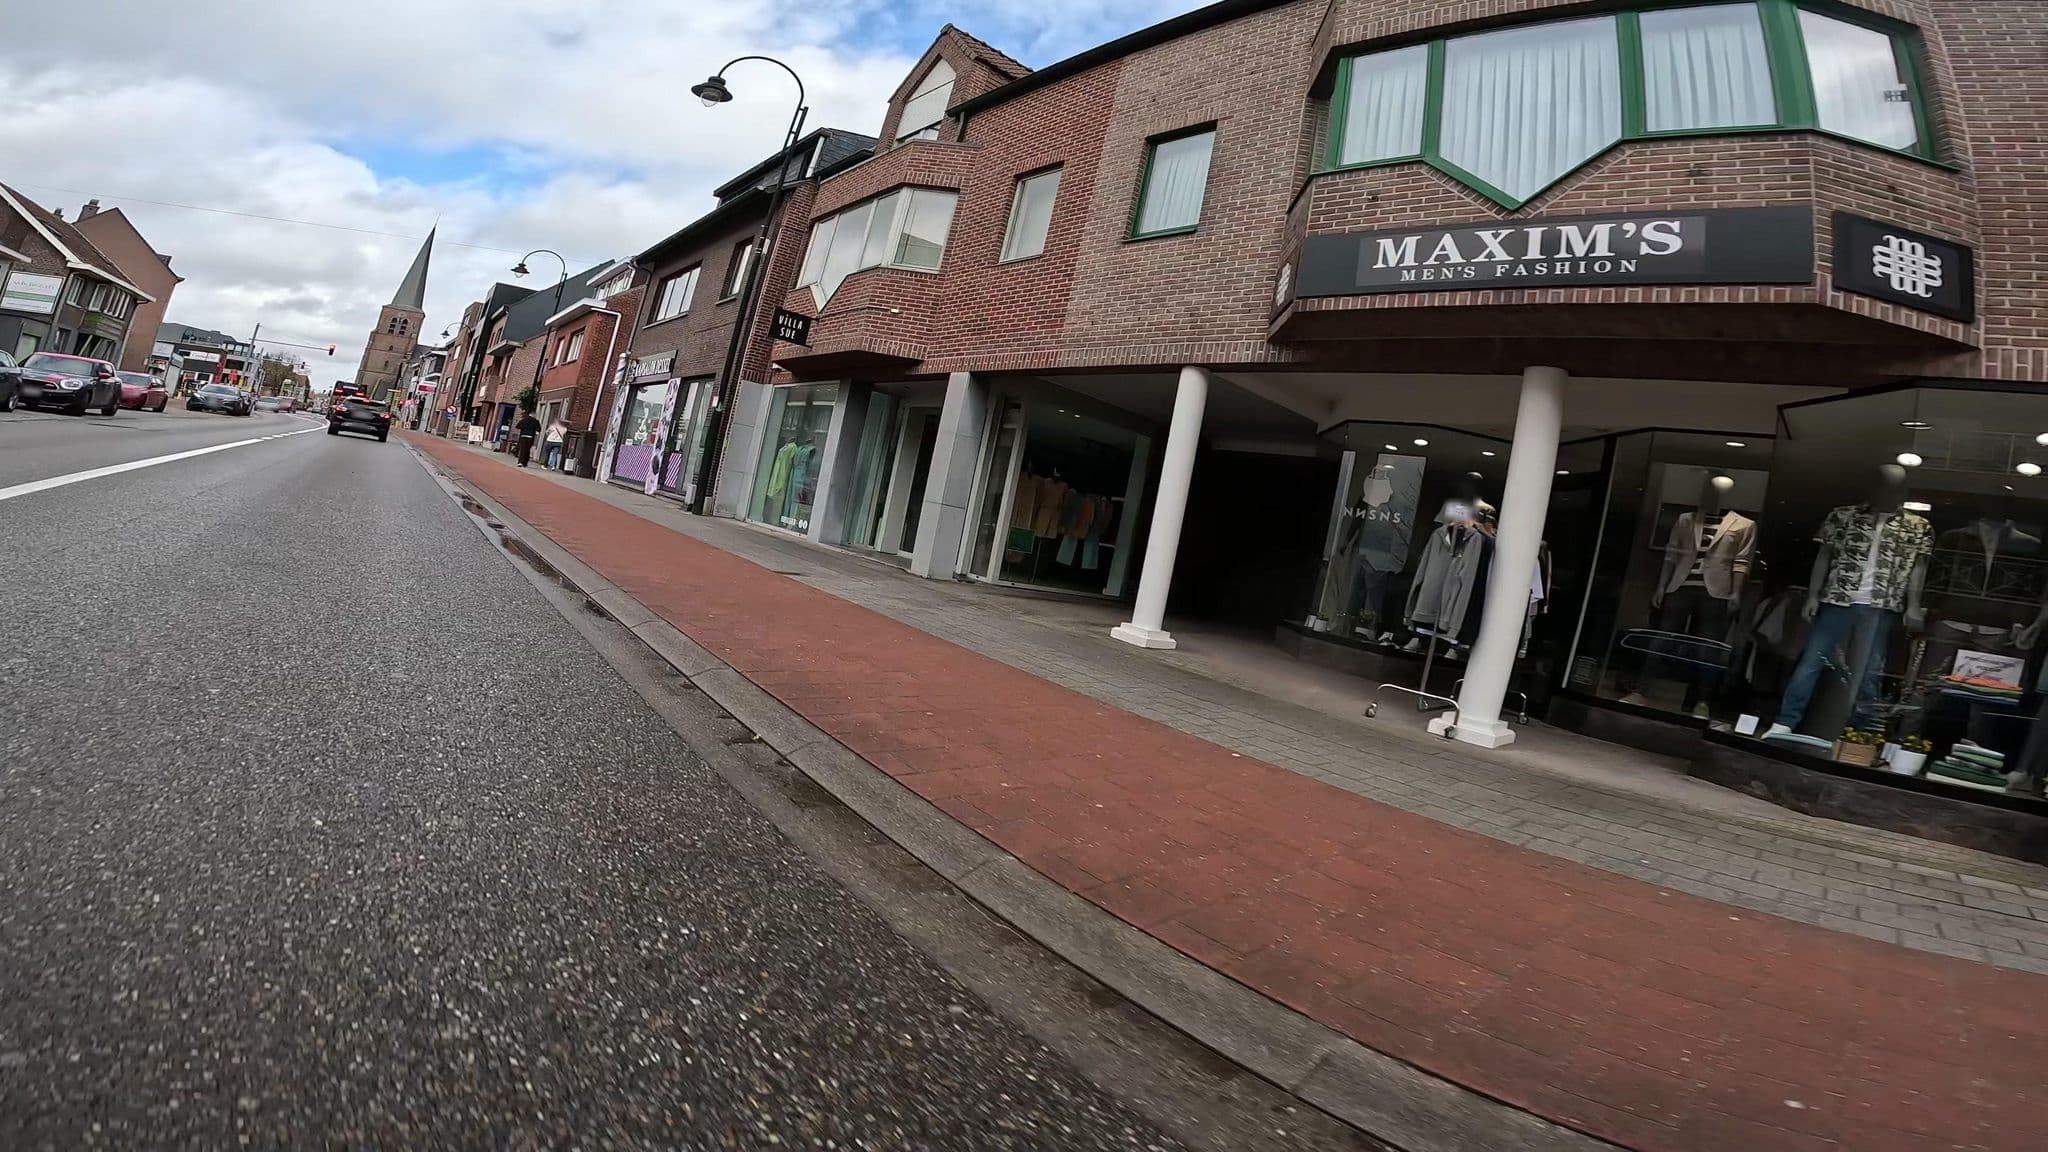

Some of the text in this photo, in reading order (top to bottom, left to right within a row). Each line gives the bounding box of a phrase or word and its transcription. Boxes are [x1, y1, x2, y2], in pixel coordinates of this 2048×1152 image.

[1372, 220, 1684, 269] MAXIM'S
[1400, 259, 1638, 282] MEN'S FASHION
[779, 327, 796, 340] SUE
